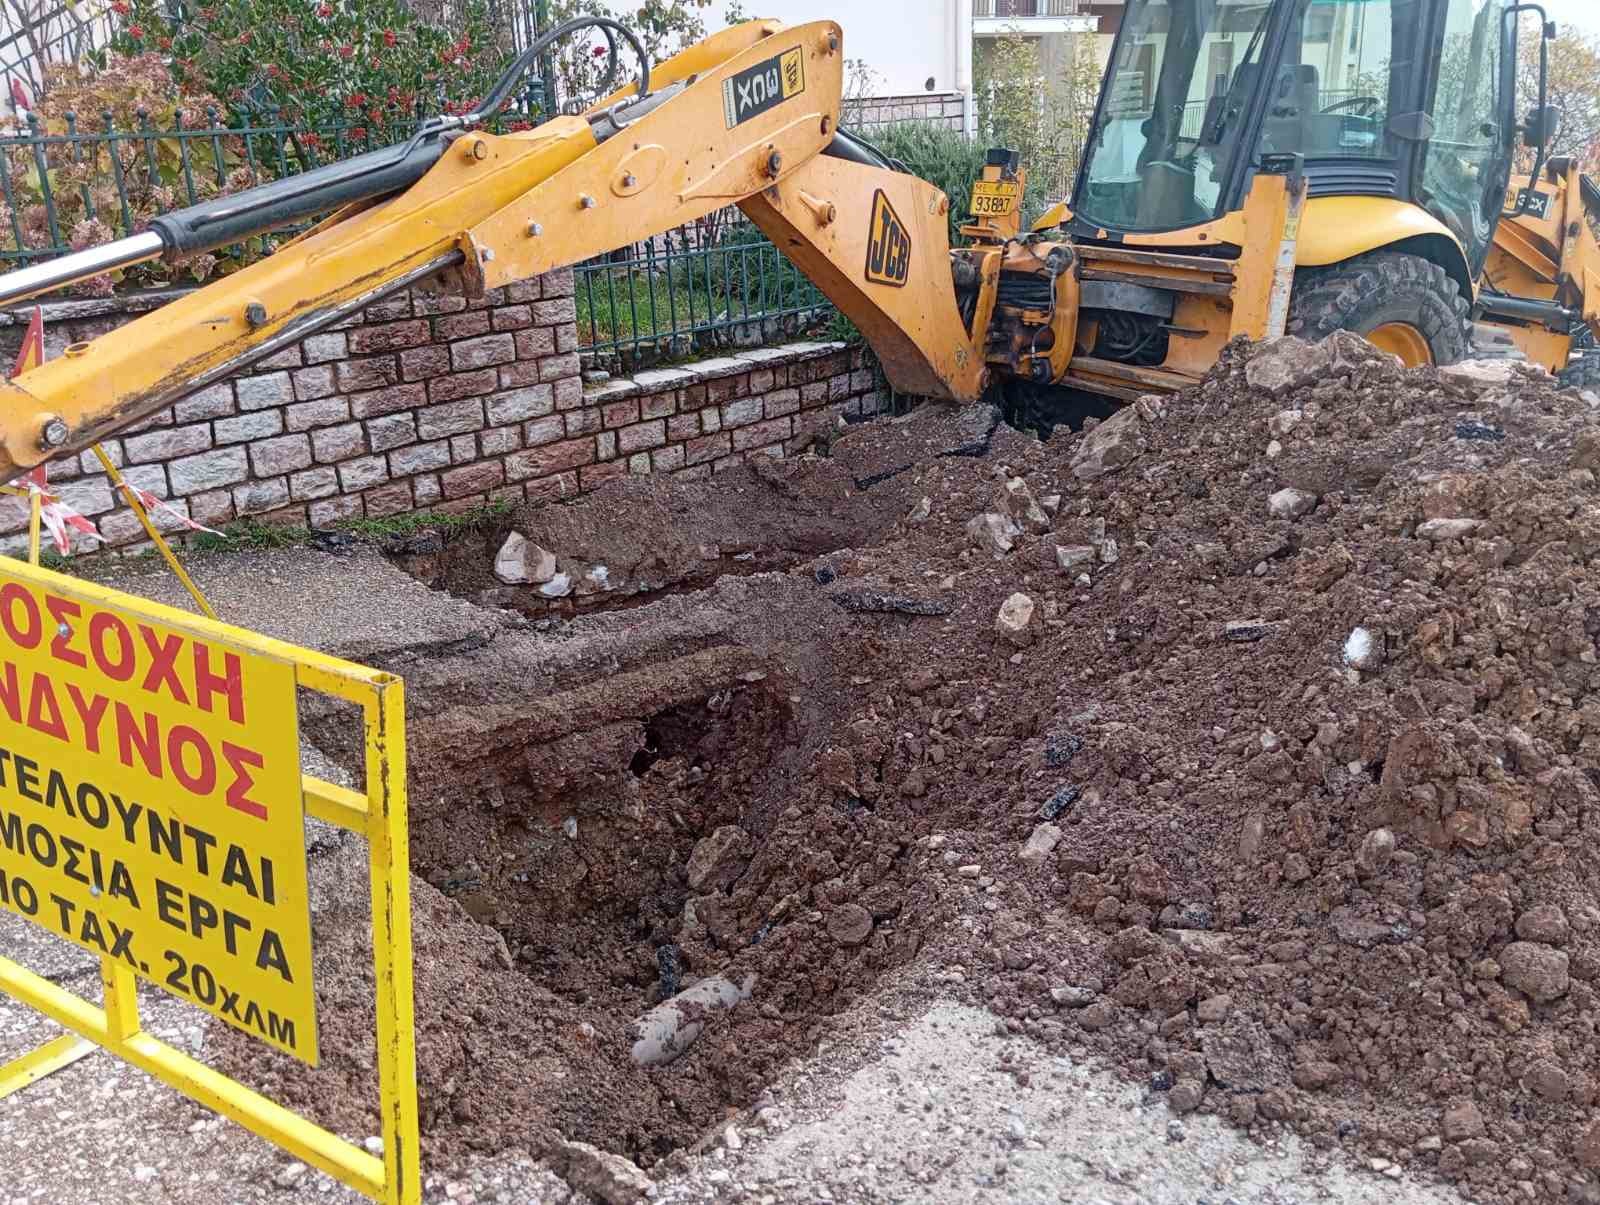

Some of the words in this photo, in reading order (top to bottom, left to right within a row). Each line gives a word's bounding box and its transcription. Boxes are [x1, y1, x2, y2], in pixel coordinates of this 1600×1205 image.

[871, 207, 907, 280] JCB
[0, 583, 245, 725] ΟΣΟΧΗ
[50, 892, 149, 974] ΤΑΧ.
[155, 878, 293, 983] ΕΡΓΑ
